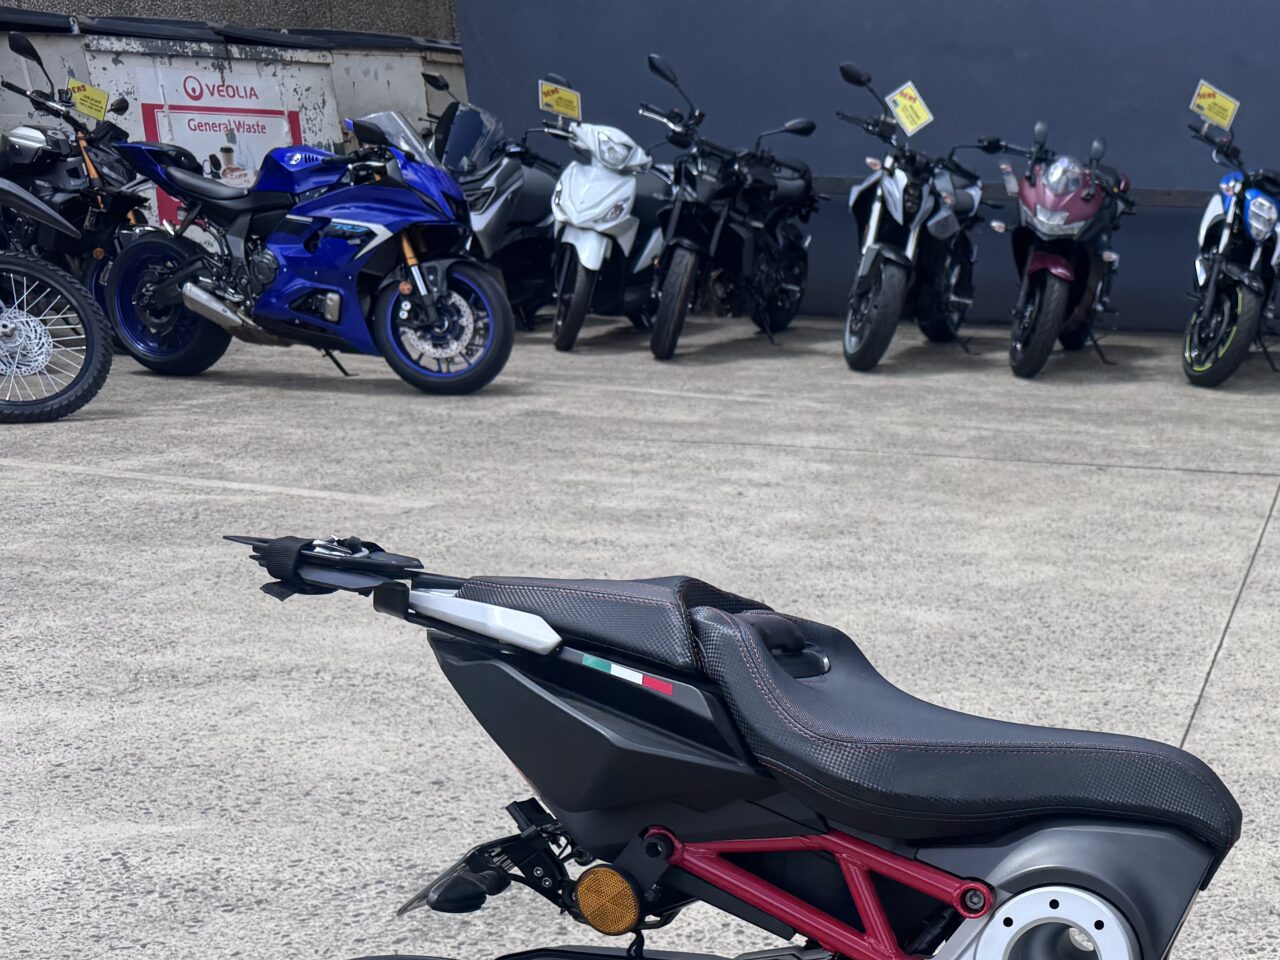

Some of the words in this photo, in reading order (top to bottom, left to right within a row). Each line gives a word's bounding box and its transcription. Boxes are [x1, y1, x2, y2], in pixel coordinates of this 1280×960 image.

[205, 82, 259, 100] VEOLIA
[187, 118, 231, 133] General
[233, 120, 267, 135] Waste
